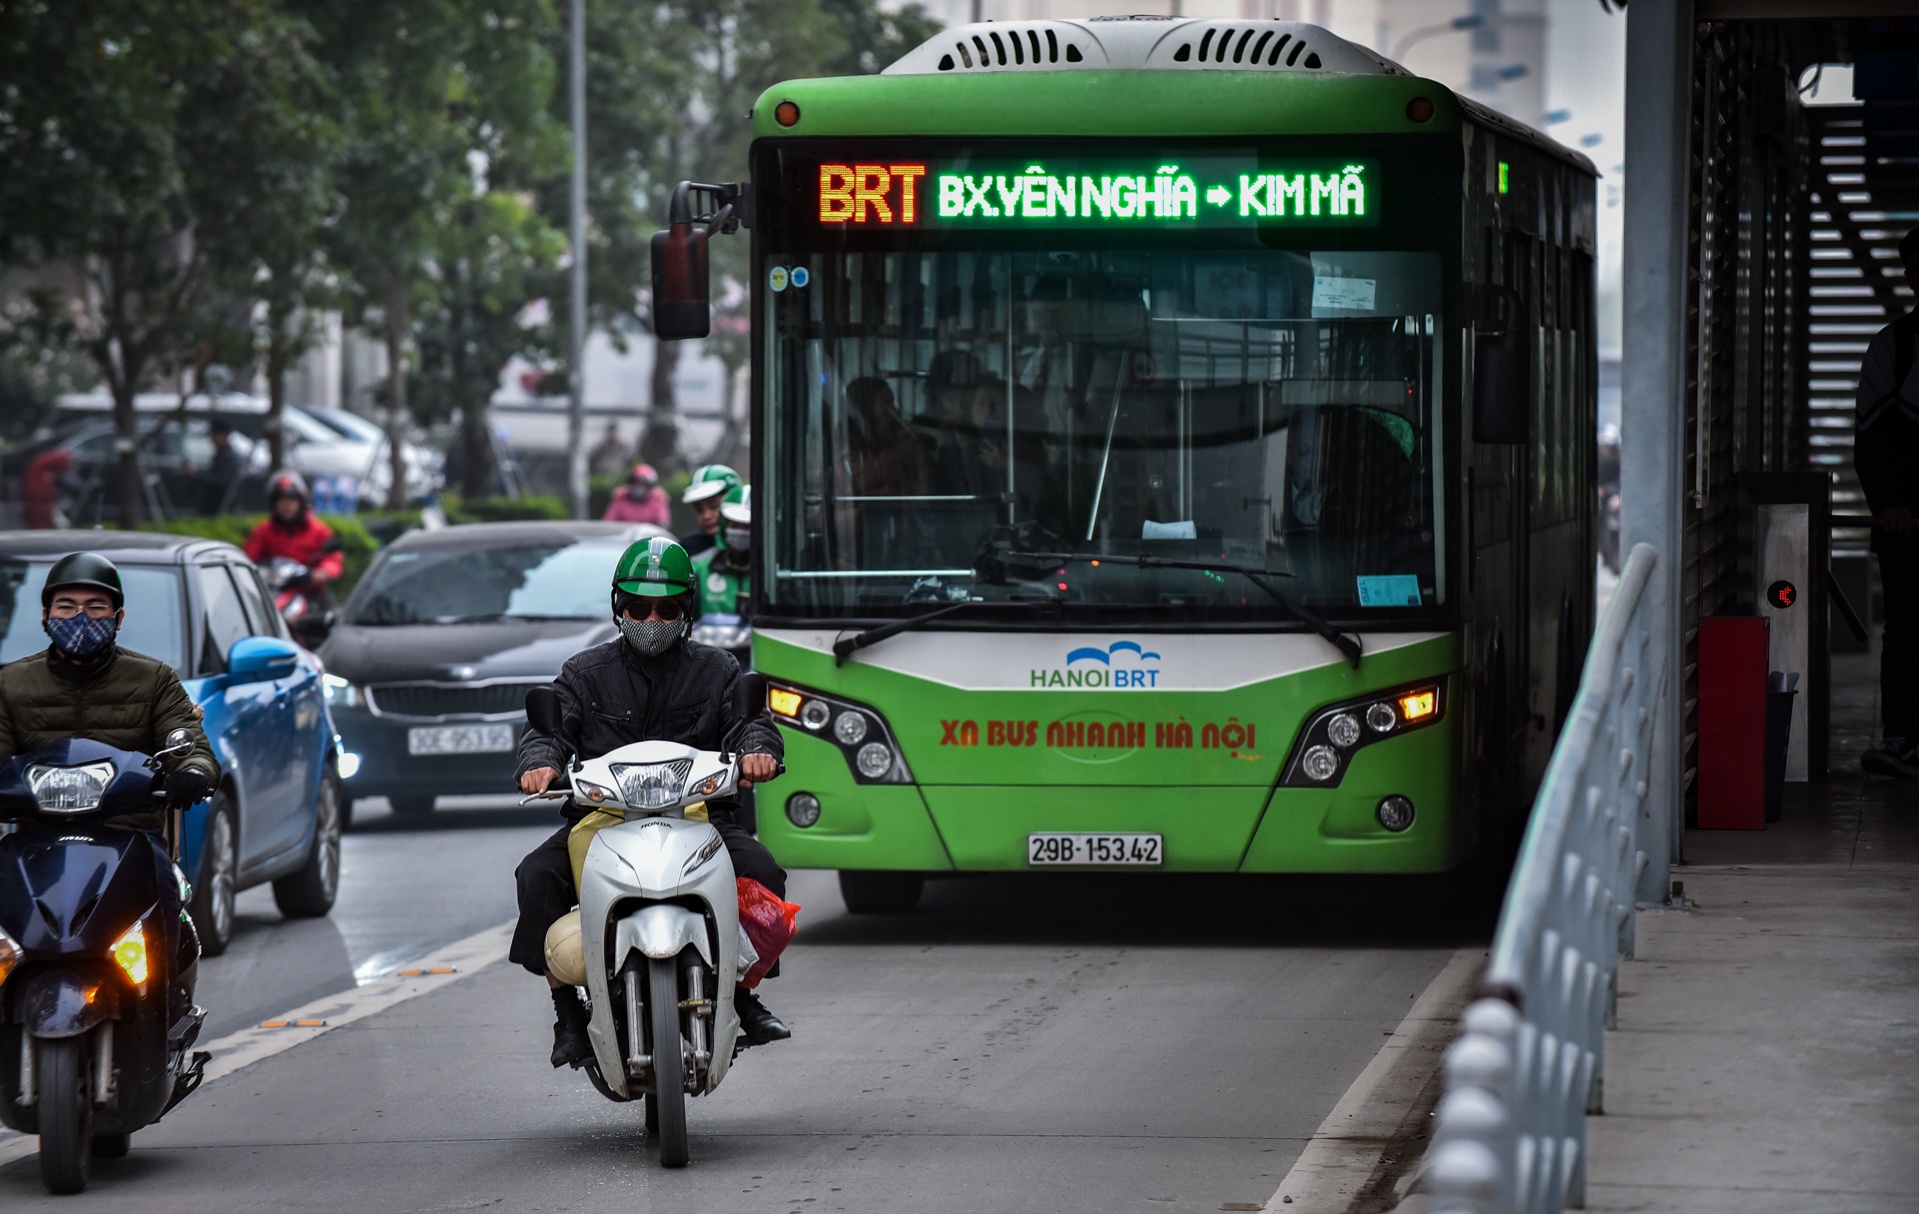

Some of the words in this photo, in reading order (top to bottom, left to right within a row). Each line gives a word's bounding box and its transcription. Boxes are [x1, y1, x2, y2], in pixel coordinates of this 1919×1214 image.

[820, 165, 925, 222] BRT
[1081, 165, 1196, 217] NGHĨA
[1240, 174, 1304, 216] KIM
[1310, 165, 1364, 215] MÃ
[1031, 669, 1110, 687] HANOI
[1114, 669, 1160, 687] BRT
[987, 720, 1039, 747] BUS
[1046, 721, 1146, 748] NHANH
[1155, 715, 1193, 748] HÀ
[1201, 717, 1256, 758] NỘI
[640, 821, 672, 829] HONDA
[1032, 837, 1158, 862] 29B-153.42
